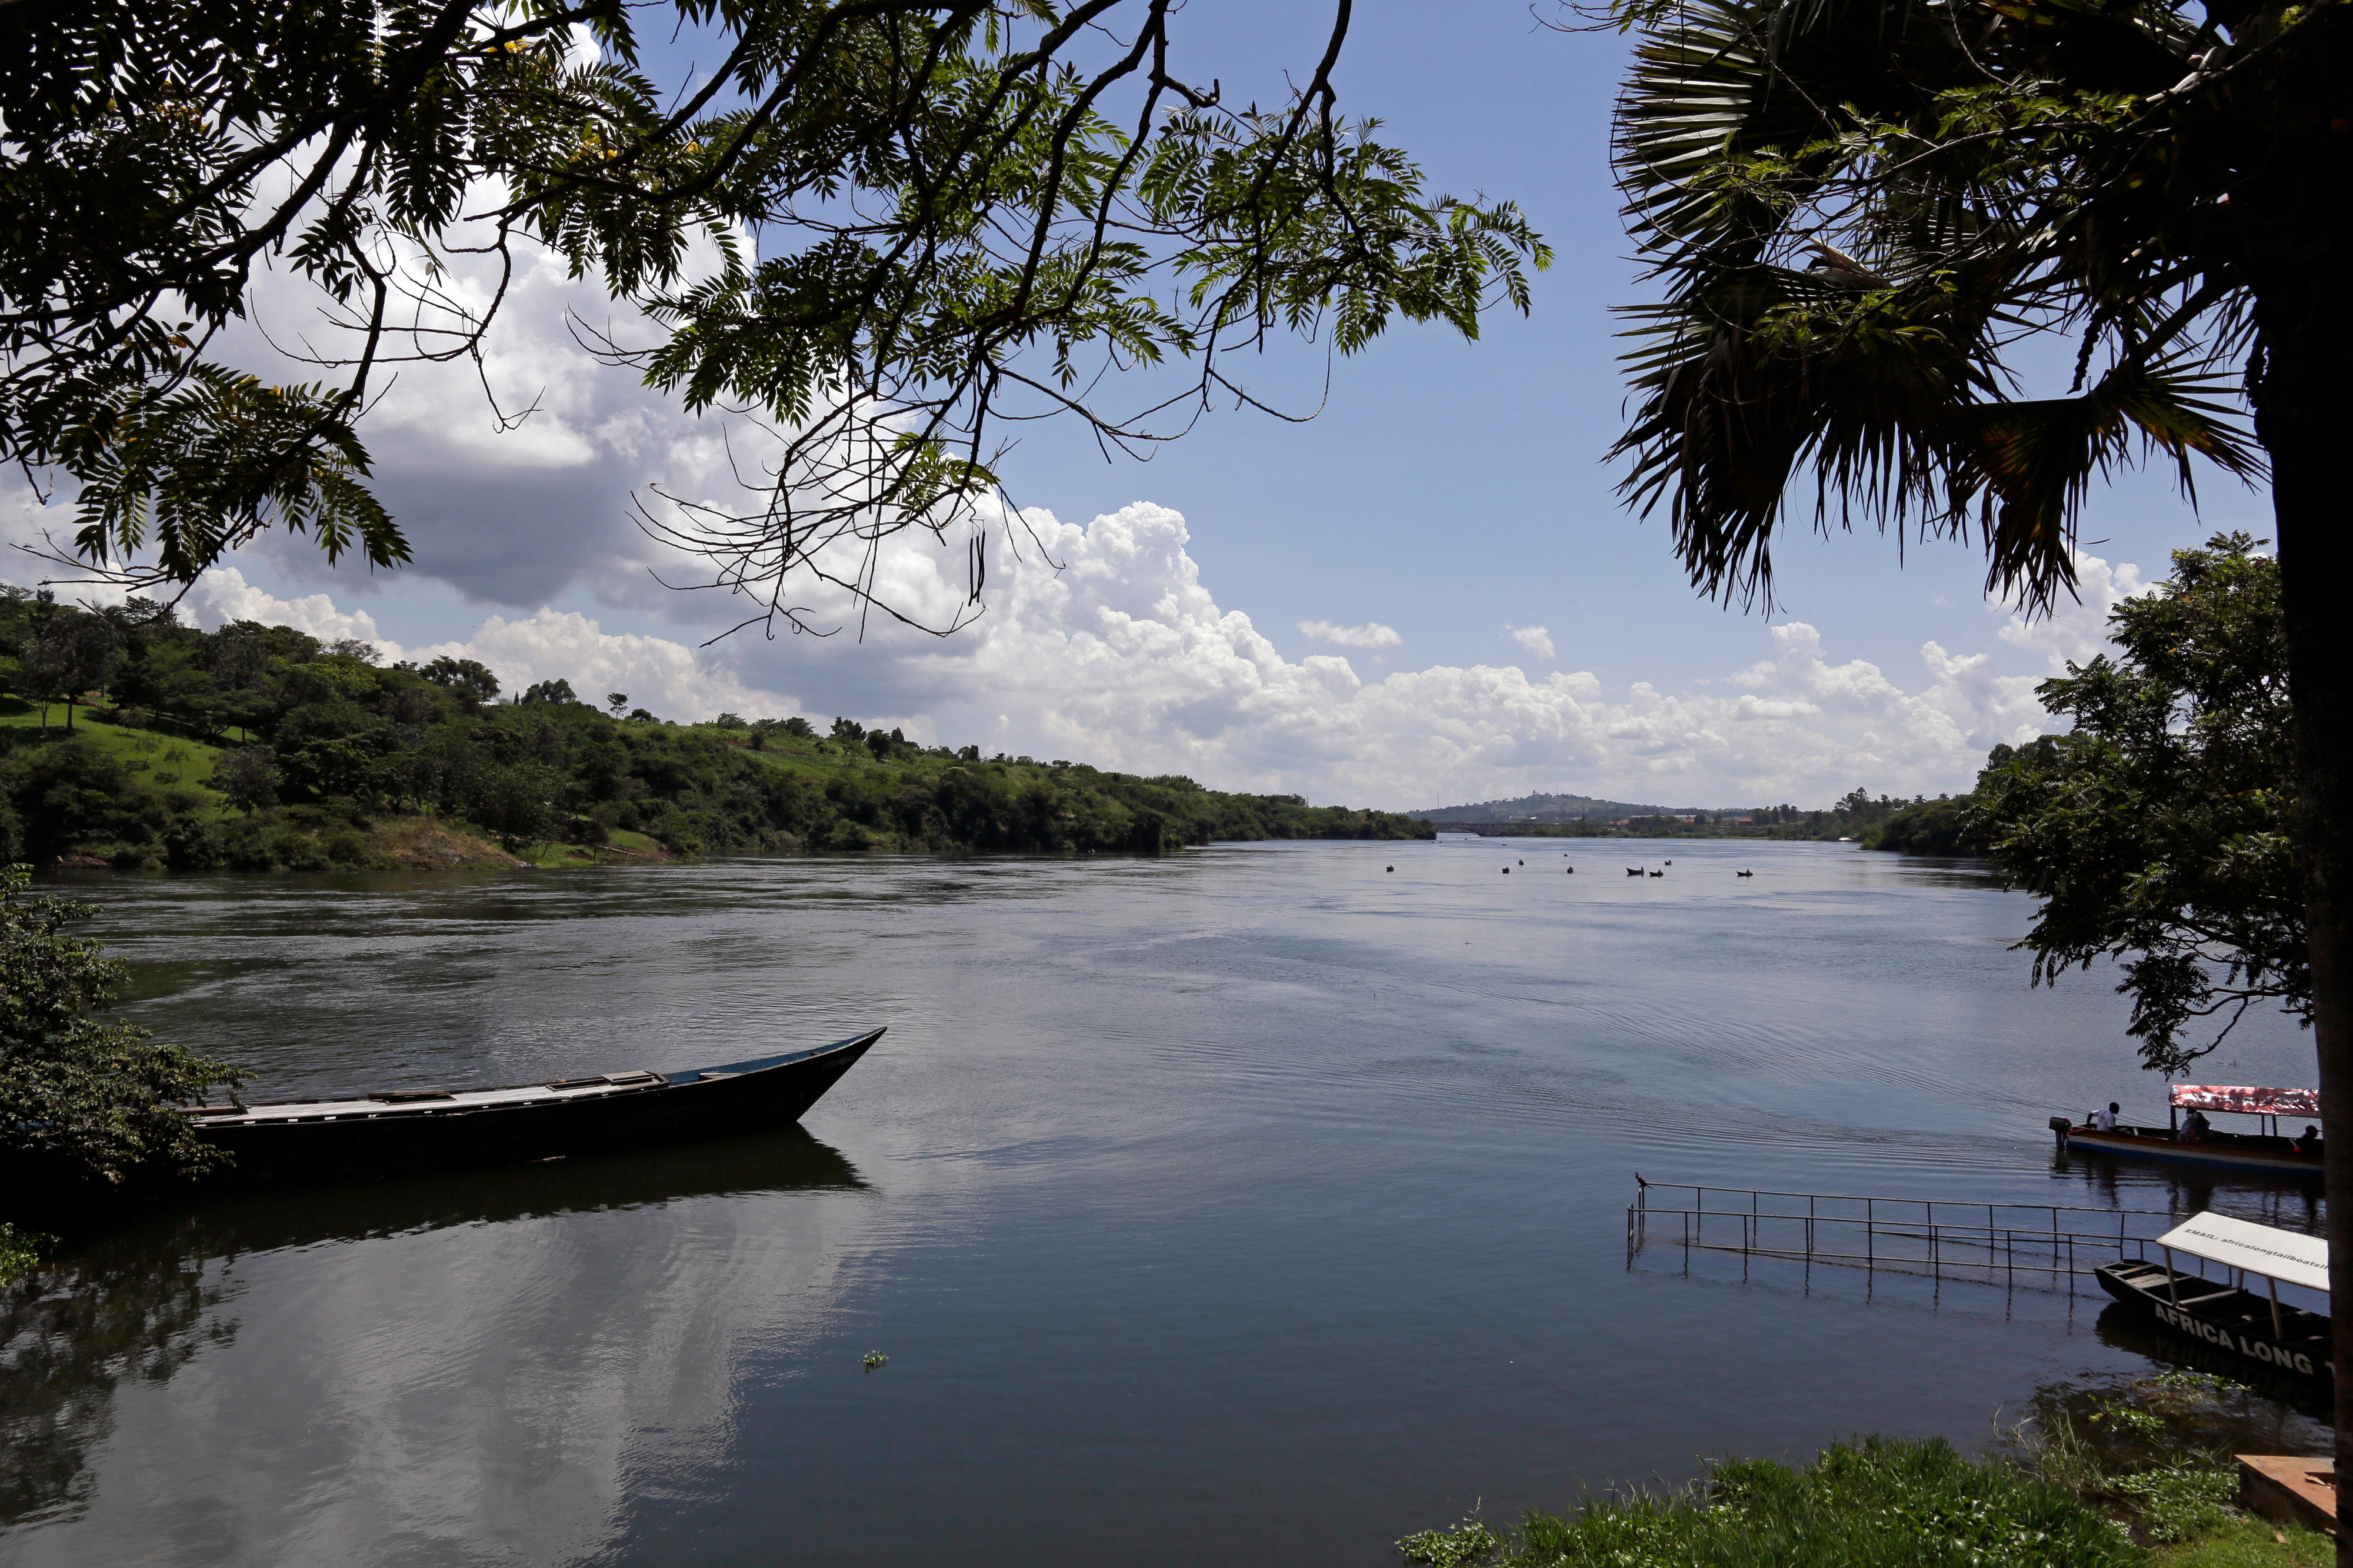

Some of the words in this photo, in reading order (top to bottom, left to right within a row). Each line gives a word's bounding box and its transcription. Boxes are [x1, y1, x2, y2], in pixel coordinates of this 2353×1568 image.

[2185, 1228, 2219, 1240] EMAIL:
[2155, 1302, 2235, 1351] AFRICA
[2239, 1335, 2314, 1376] LONG
